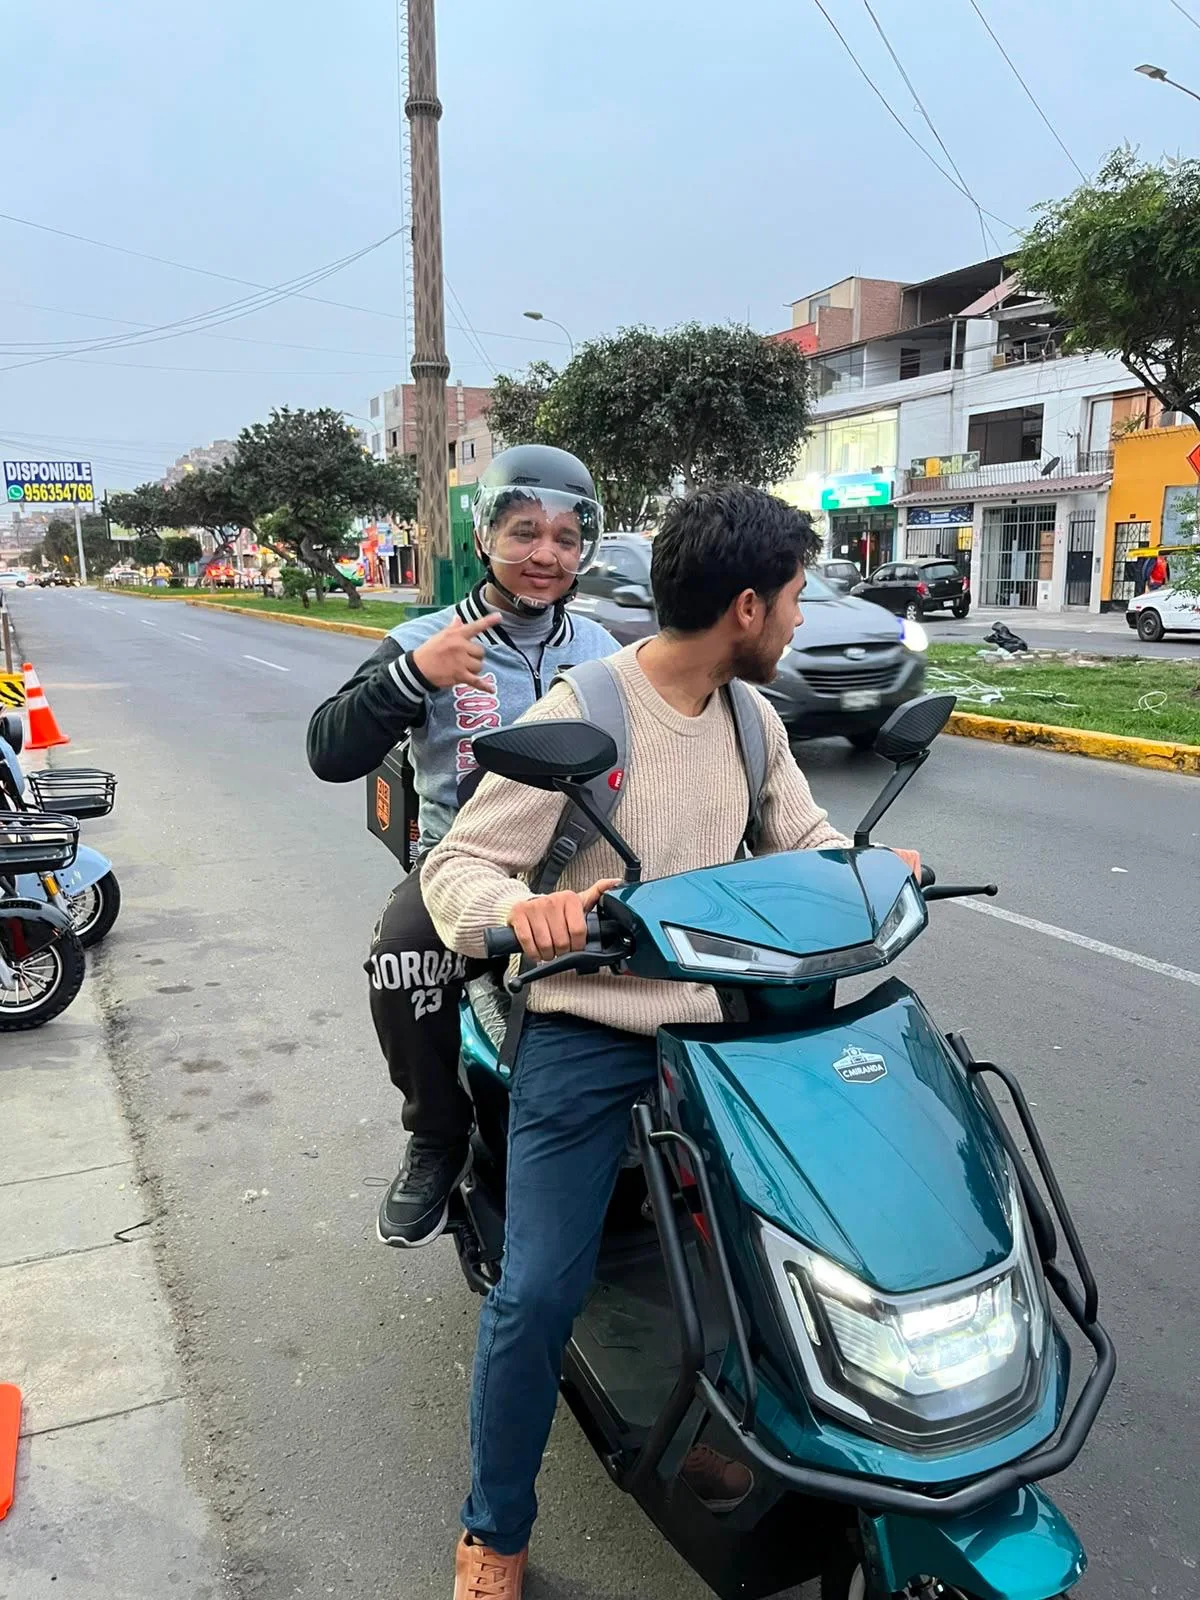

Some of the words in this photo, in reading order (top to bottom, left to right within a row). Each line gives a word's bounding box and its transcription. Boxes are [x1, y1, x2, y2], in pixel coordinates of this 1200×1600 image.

[5, 462, 91, 481] DISPONIBLE
[24, 483, 93, 501] 956354768
[371, 950, 467, 990] JORDAN
[411, 988, 443, 1021] 23
